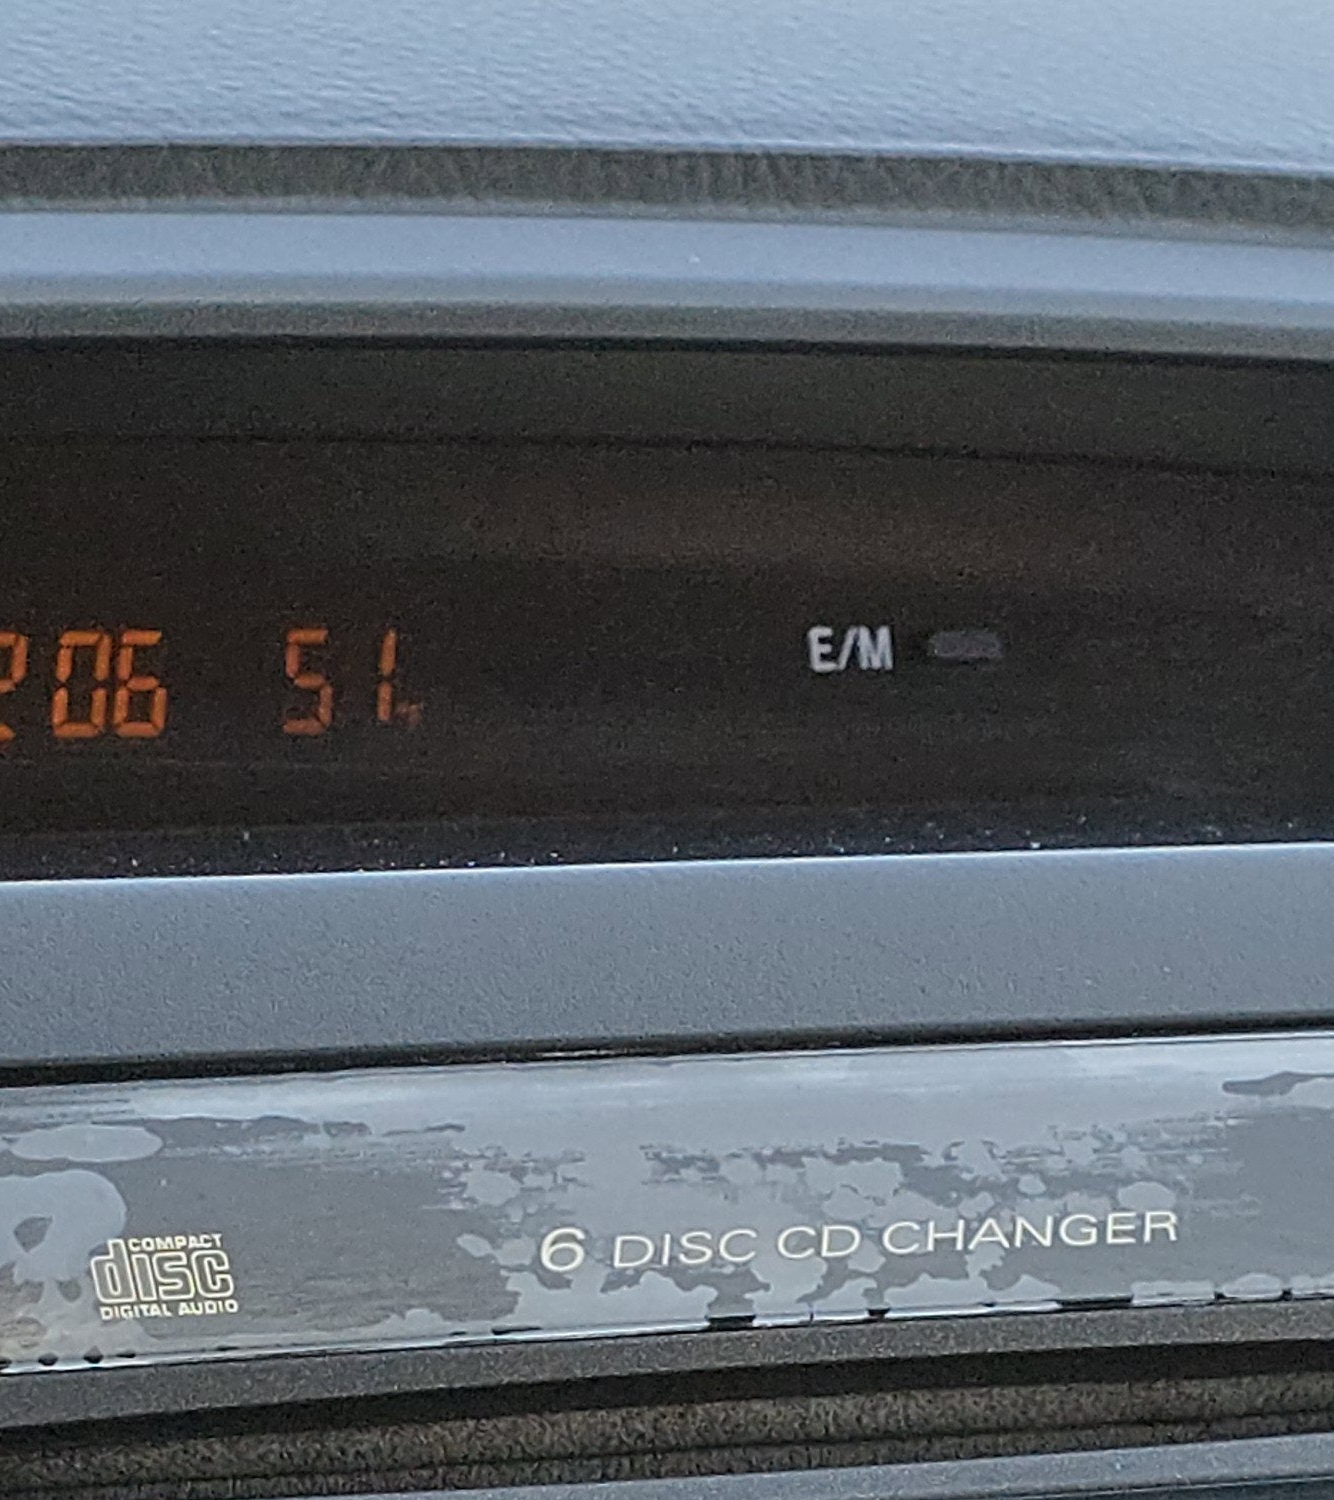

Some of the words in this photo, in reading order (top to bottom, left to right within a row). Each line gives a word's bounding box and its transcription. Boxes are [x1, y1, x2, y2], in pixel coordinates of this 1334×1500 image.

[806, 624, 895, 675] E/M
[127, 1233, 223, 1251] COMPACT
[538, 1226, 586, 1273] 6
[611, 1228, 758, 1269] DISC
[777, 1222, 862, 1260] CD
[880, 1209, 1180, 1257] CHANGER
[100, 1303, 172, 1320] DIGITAL
[178, 1299, 239, 1316] AUDIO
